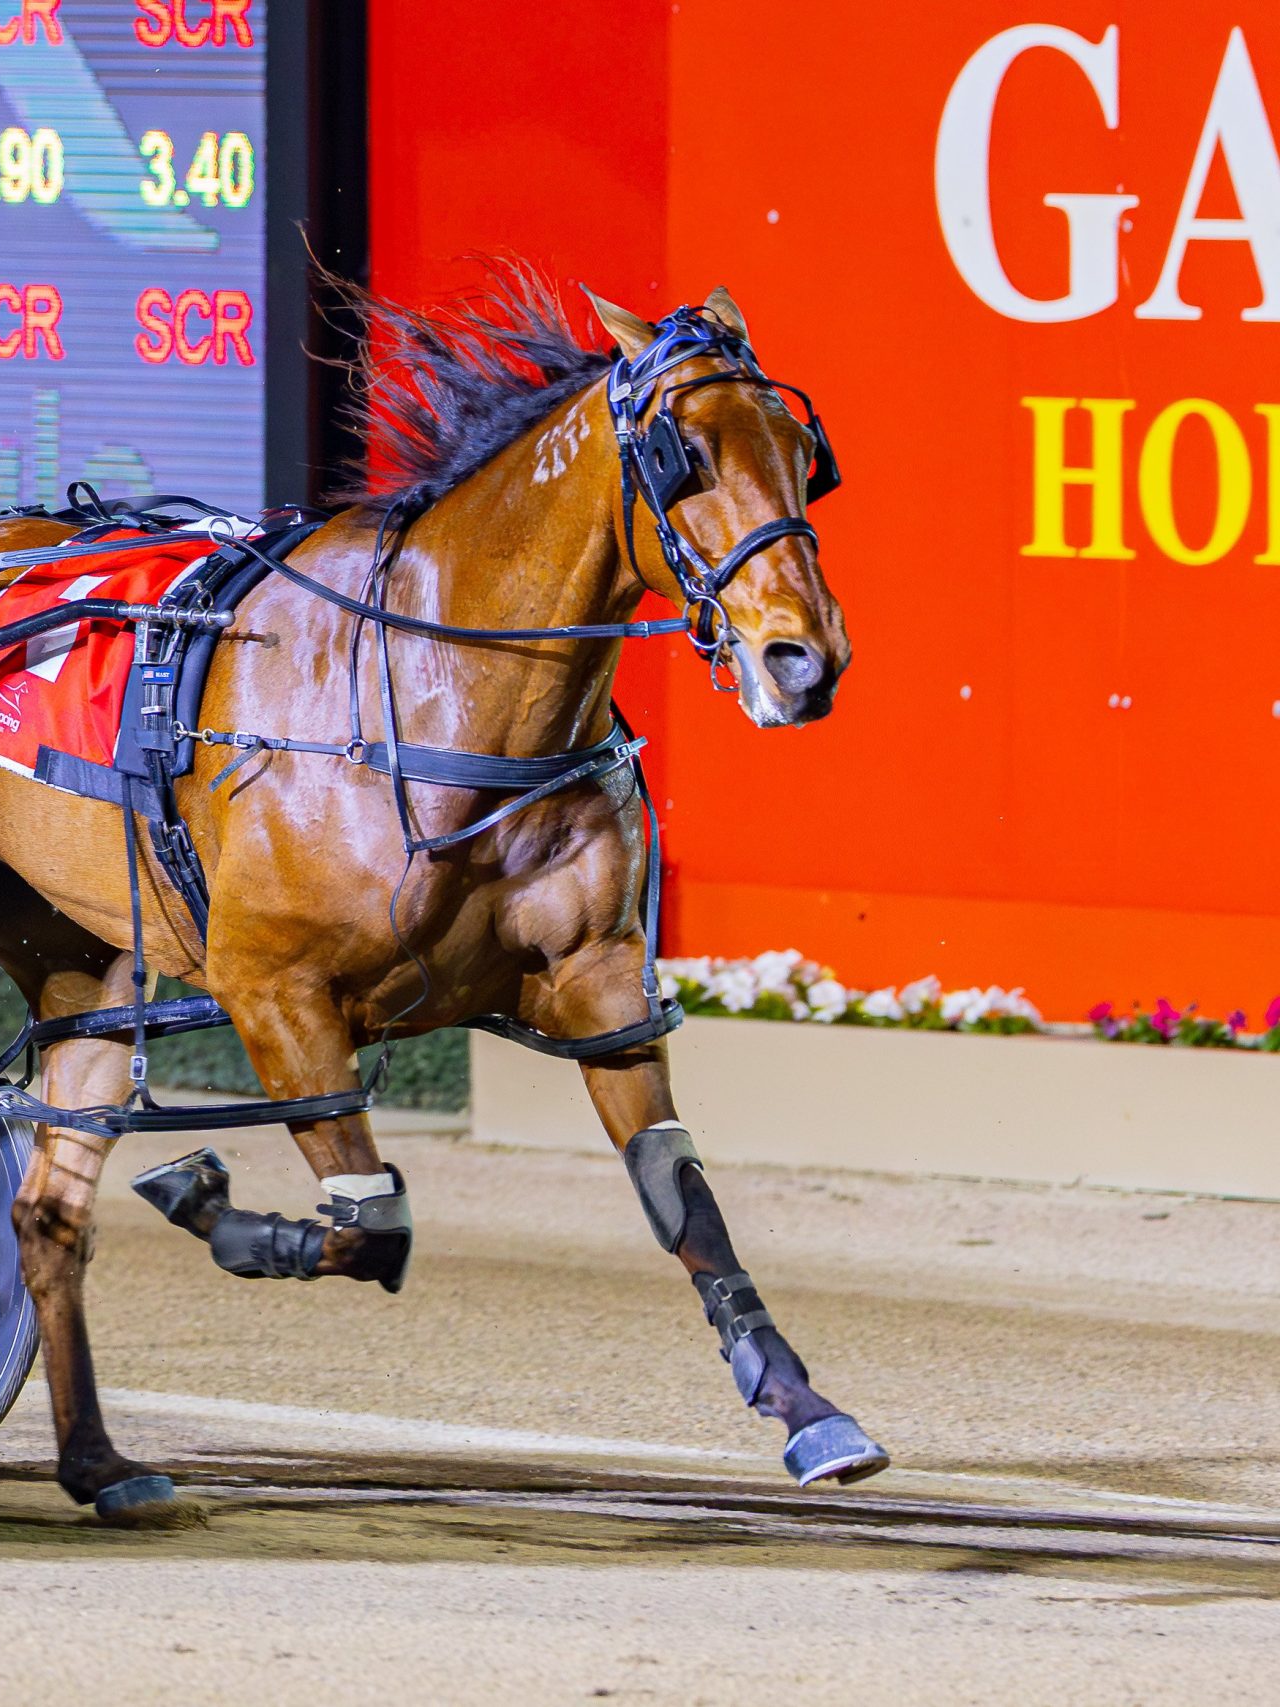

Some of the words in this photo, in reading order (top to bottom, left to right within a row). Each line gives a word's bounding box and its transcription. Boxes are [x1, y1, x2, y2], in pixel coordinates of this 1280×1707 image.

[133, 0, 254, 47] SCR
[139, 130, 254, 207] 3.40
[934, 22, 1280, 323] GA
[134, 288, 256, 366] SCR
[1020, 396, 1280, 567] HO
